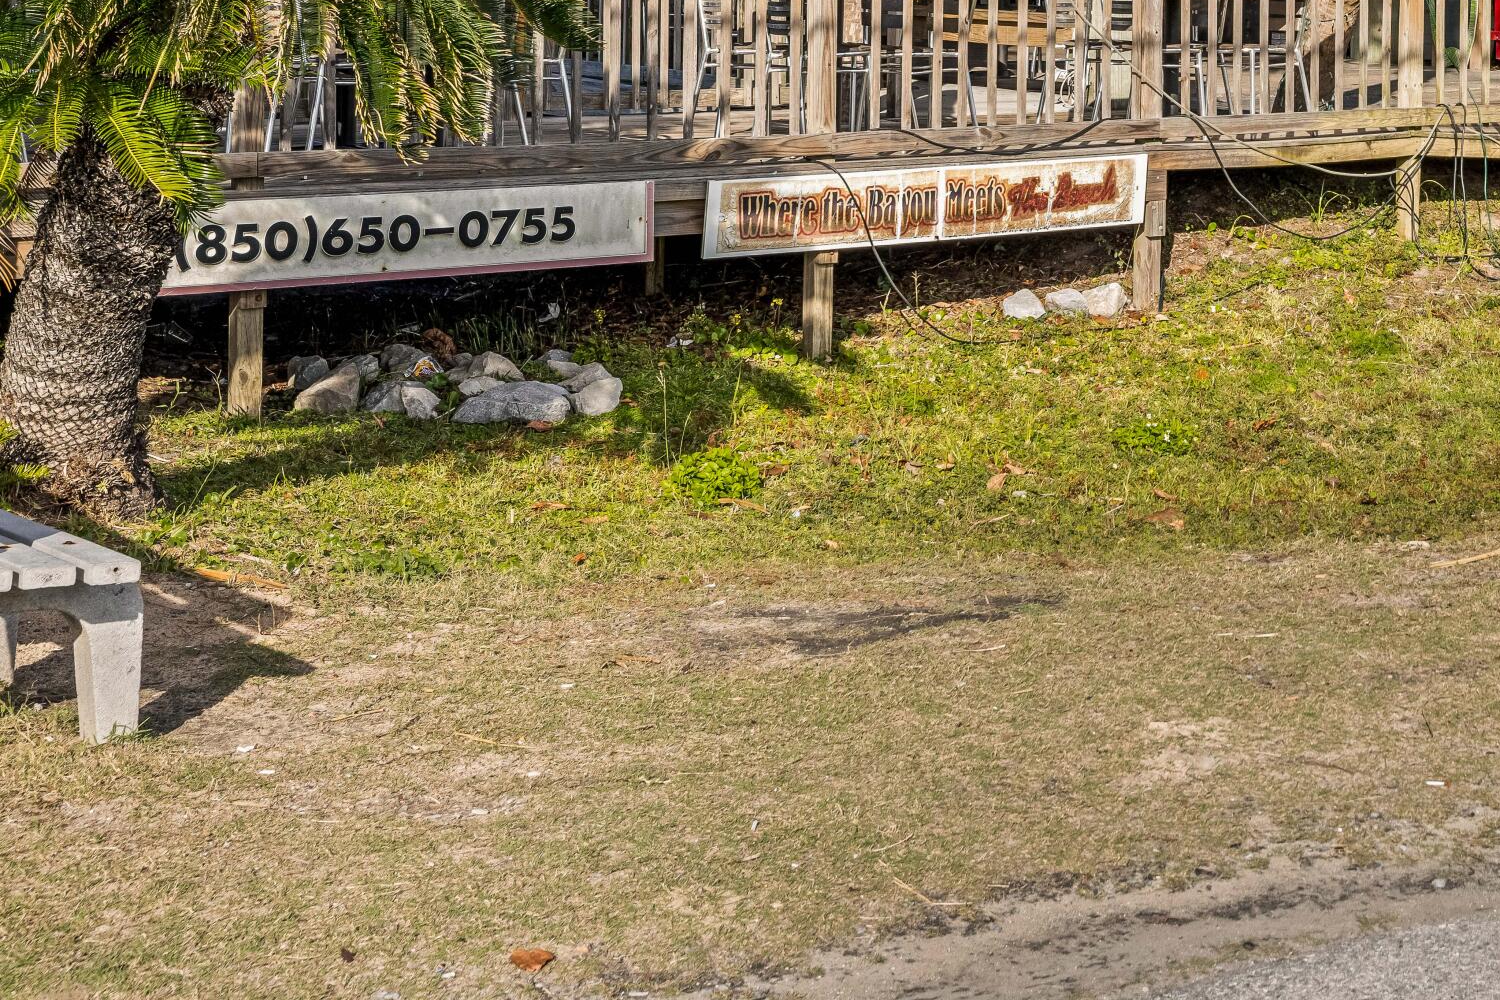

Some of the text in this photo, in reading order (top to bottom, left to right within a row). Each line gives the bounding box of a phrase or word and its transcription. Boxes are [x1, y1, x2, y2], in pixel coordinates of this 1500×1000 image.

[740, 191, 818, 238] Where
[820, 188, 861, 233] the
[867, 185, 938, 235] Bayou
[945, 179, 1006, 223] Meets
